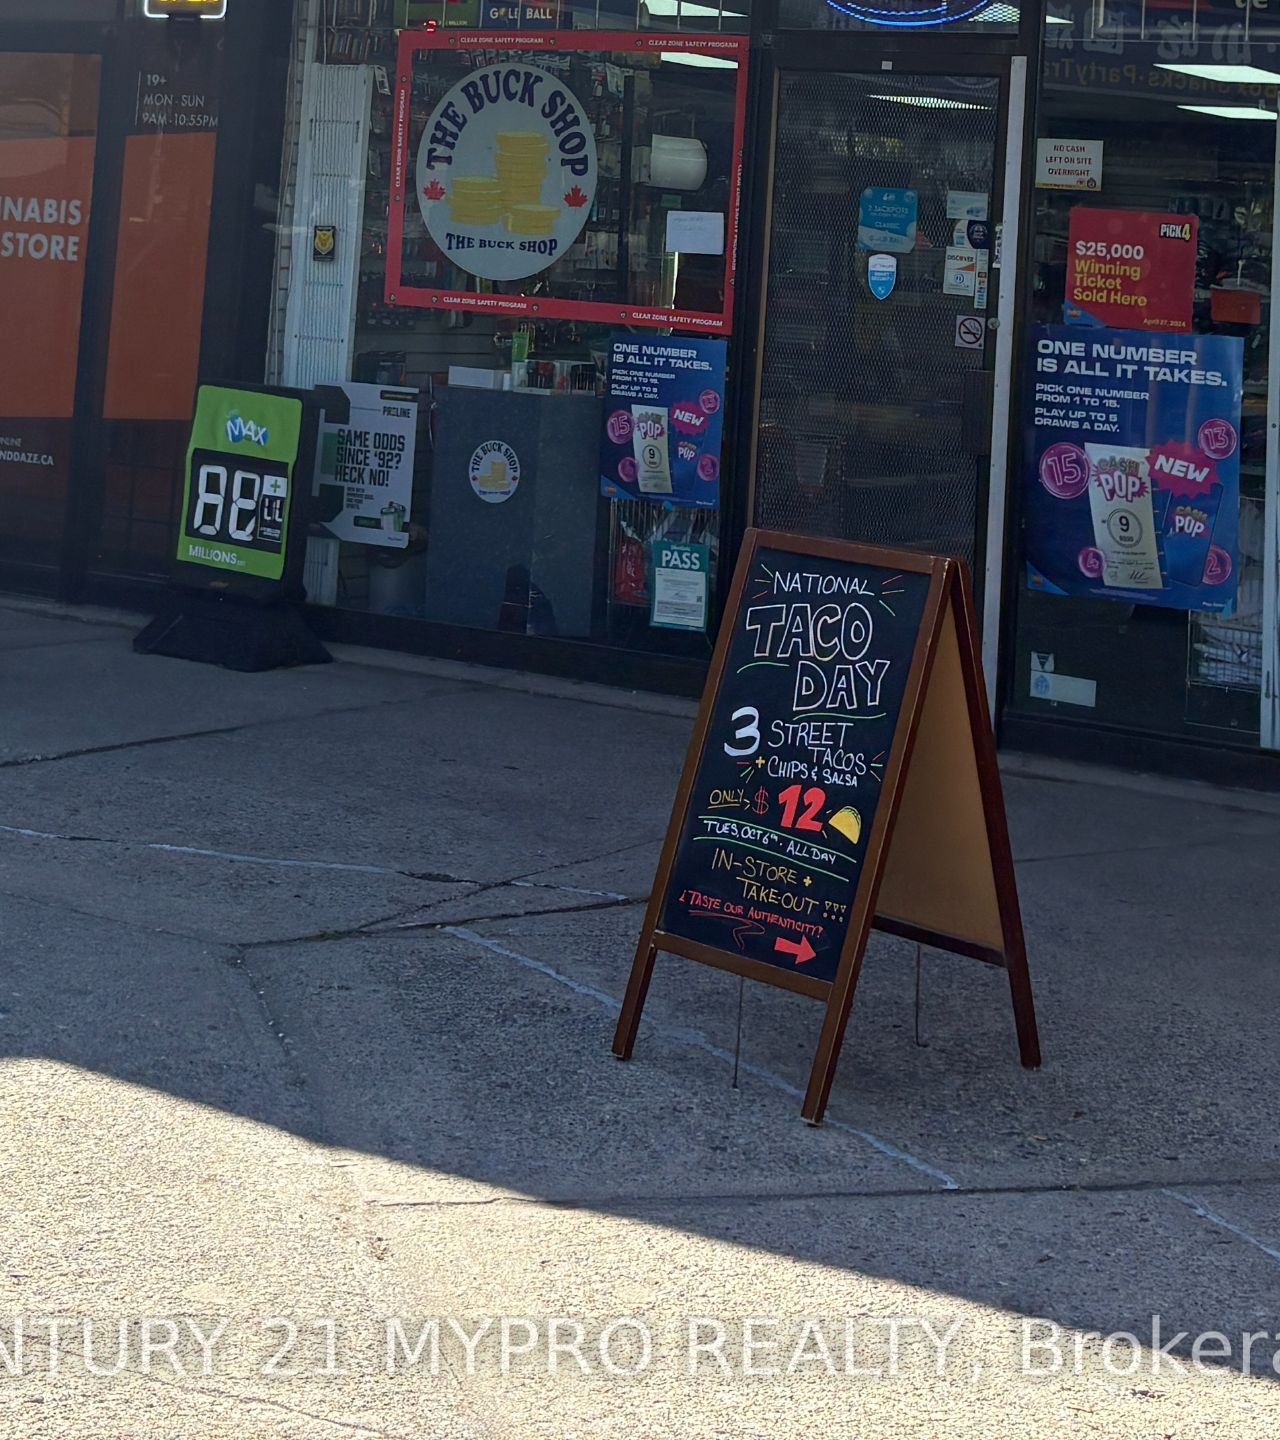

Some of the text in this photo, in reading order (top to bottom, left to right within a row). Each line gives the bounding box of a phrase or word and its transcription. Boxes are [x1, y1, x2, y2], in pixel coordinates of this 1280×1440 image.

[526, 10, 552, 20] BALL
[146, 73, 168, 86] 19+
[143, 93, 205, 108] MON SUN
[426, 69, 589, 176] THE BUCK SHOP
[0, 231, 80, 262] STORE
[445, 232, 558, 256] THE BUCK SHOP
[1075, 240, 1144, 261] $25,000
[1074, 273, 1122, 290] Ticket
[1075, 259, 1141, 281] Winning
[1073, 287, 1148, 307] Sold Here
[613, 343, 697, 359] ONE NUMBER
[613, 354, 712, 371] IS ALL IT TAKES.
[1037, 340, 1197, 365] ONE NUMBER
[1036, 357, 1228, 387] IS ALL IT TAKES.
[1035, 383, 1150, 401] PICK ONE NUMBER
[1035, 393, 1071, 404] FROM
[1082, 397, 1100, 406] TO
[611, 415, 631, 437] 15
[674, 409, 704, 427] NEW
[1034, 417, 1120, 433] DRAWS A DAY.
[1035, 407, 1066, 418] PLAY
[1069, 410, 1086, 420] UP
[1088, 412, 1106, 421] TO
[226, 415, 268, 447] MAX
[337, 428, 406, 452] SAME ODDS
[336, 446, 371, 467] SINCE
[1048, 427, 1228, 487] 15 NEW 13
[334, 465, 390, 487] HECK NO!
[1099, 473, 1140, 503] POP
[1119, 515, 1130, 533] 9
[1174, 515, 1205, 538] POP
[188, 544, 238, 565] MILLIONS
[661, 550, 700, 570] PASS
[773, 571, 875, 596] NATIONAL
[746, 603, 873, 661] TACO
[793, 659, 890, 711] DAY
[724, 706, 854, 757] 3 STREET
[767, 756, 809, 780] CHIPS
[822, 769, 858, 788] SALSA
[808, 746, 867, 775] TACOS
[709, 789, 745, 806] ONLY
[778, 784, 826, 832] 12
[786, 841, 810, 858] ALL
[810, 847, 837, 865] DAY
[712, 848, 798, 885] IN-STORE
[736, 876, 819, 915] TAKE-OUT
[724, 902, 744, 914] OUR
